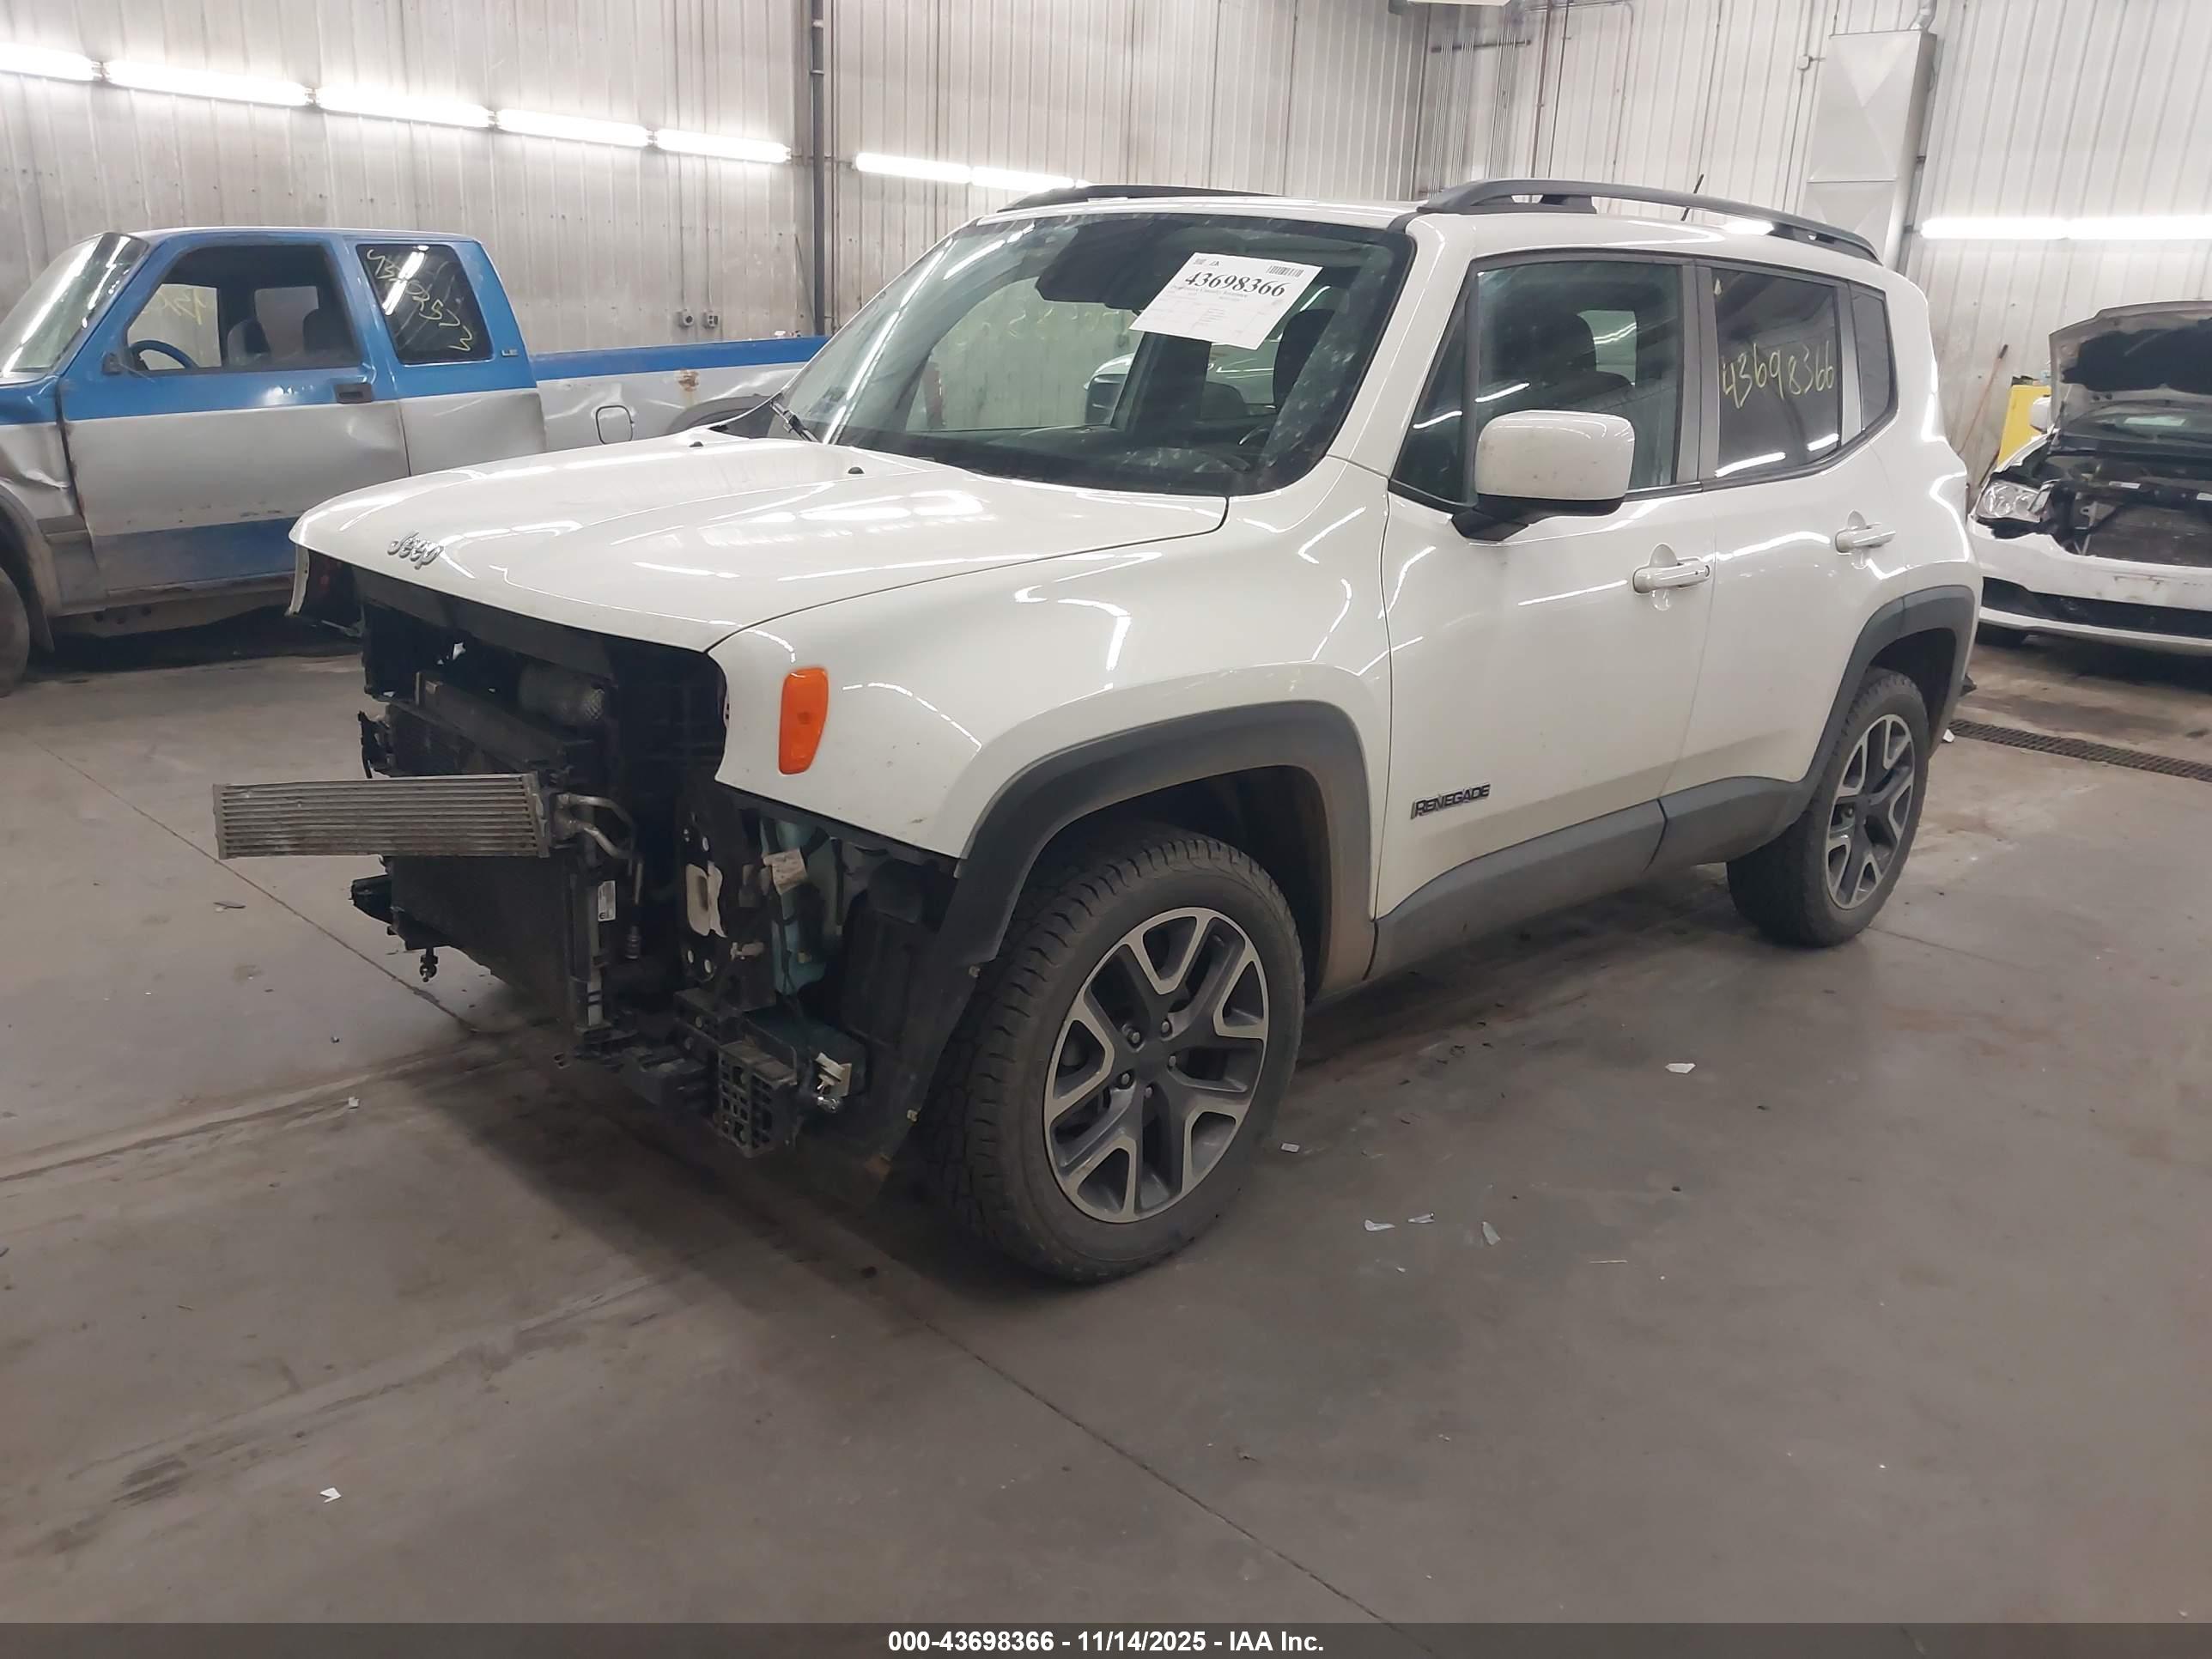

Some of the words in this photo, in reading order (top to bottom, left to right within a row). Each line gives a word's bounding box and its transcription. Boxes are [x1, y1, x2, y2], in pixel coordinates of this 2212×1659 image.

[1184, 271, 1291, 297] 43698366
[1722, 340, 1835, 409] 43698366
[386, 529, 445, 570] Jeep
[1410, 783, 1492, 820] RENEGADE
